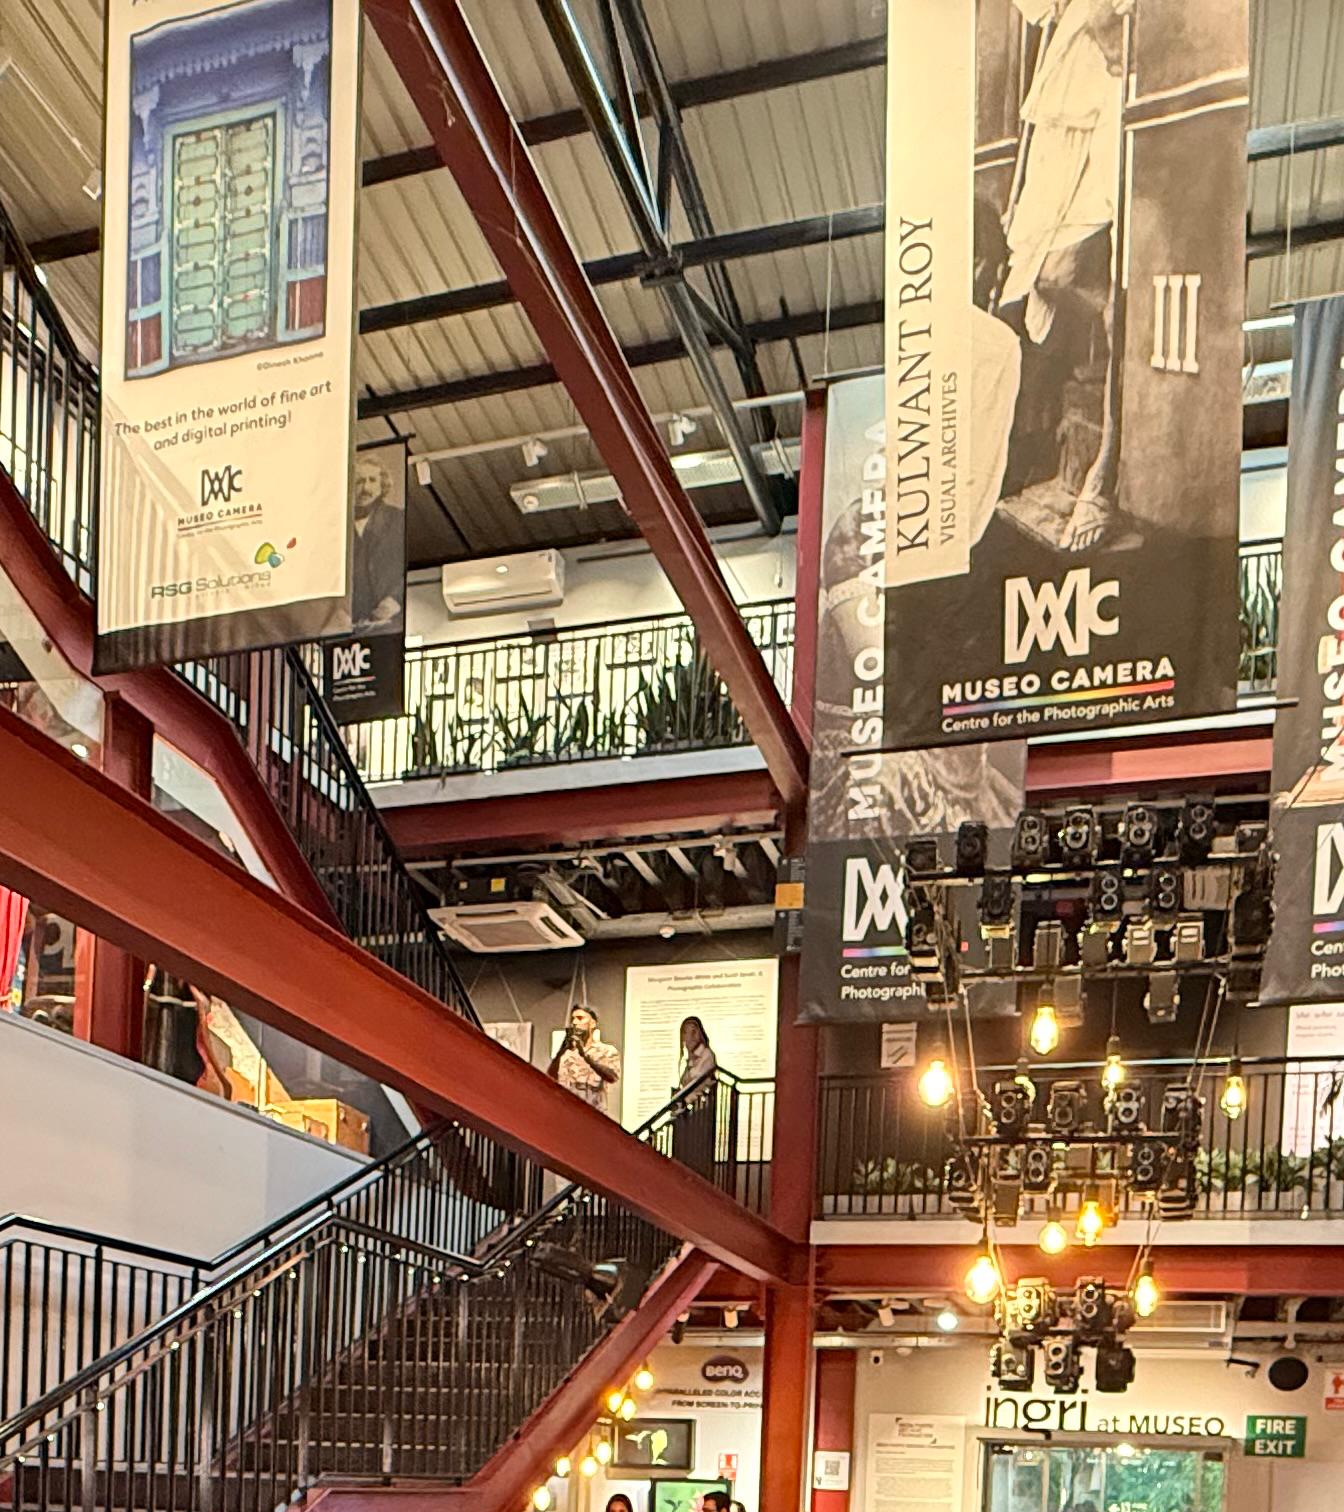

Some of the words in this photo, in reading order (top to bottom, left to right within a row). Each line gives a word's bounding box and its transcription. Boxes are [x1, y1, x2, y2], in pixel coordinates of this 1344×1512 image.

[899, 216, 933, 309] ROY
[114, 421, 141, 437] The
[144, 416, 173, 433] best
[175, 411, 188, 425] in
[191, 406, 214, 421] the
[218, 396, 257, 417] world
[260, 391, 275, 408] of
[279, 388, 307, 405] fine
[309, 380, 332, 398] art
[941, 371, 958, 469] ARCHIVES
[153, 433, 178, 451] and
[181, 421, 227, 445] digital
[230, 410, 292, 439] printing!
[896, 320, 932, 556] KULWANT
[177, 511, 214, 527] MUSEO
[217, 503, 263, 519] CAMERA
[939, 473, 956, 547] VISUAL
[151, 581, 193, 600] RSG
[195, 570, 272, 592] Solutions
[942, 673, 1041, 705] MUSEO
[1050, 656, 1176, 692] CAMERA
[847, 645, 885, 821] MUSEO
[941, 717, 990, 734] Centre
[992, 712, 1013, 728] for
[1016, 708, 1041, 725] the
[1044, 697, 1141, 722] Photographic
[1142, 694, 1175, 709] Arts
[841, 963, 887, 979] Centre
[890, 961, 911, 977] for
[841, 982, 927, 1001] Photographi
[744, 1390, 761, 1398] ACC
[985, 1385, 1089, 1440] ingri
[1098, 1415, 1121, 1433] at
[1128, 1414, 1225, 1438] MUSEO
[1254, 1440, 1296, 1455] EXIT
[1255, 1419, 1296, 1435] FIRE
